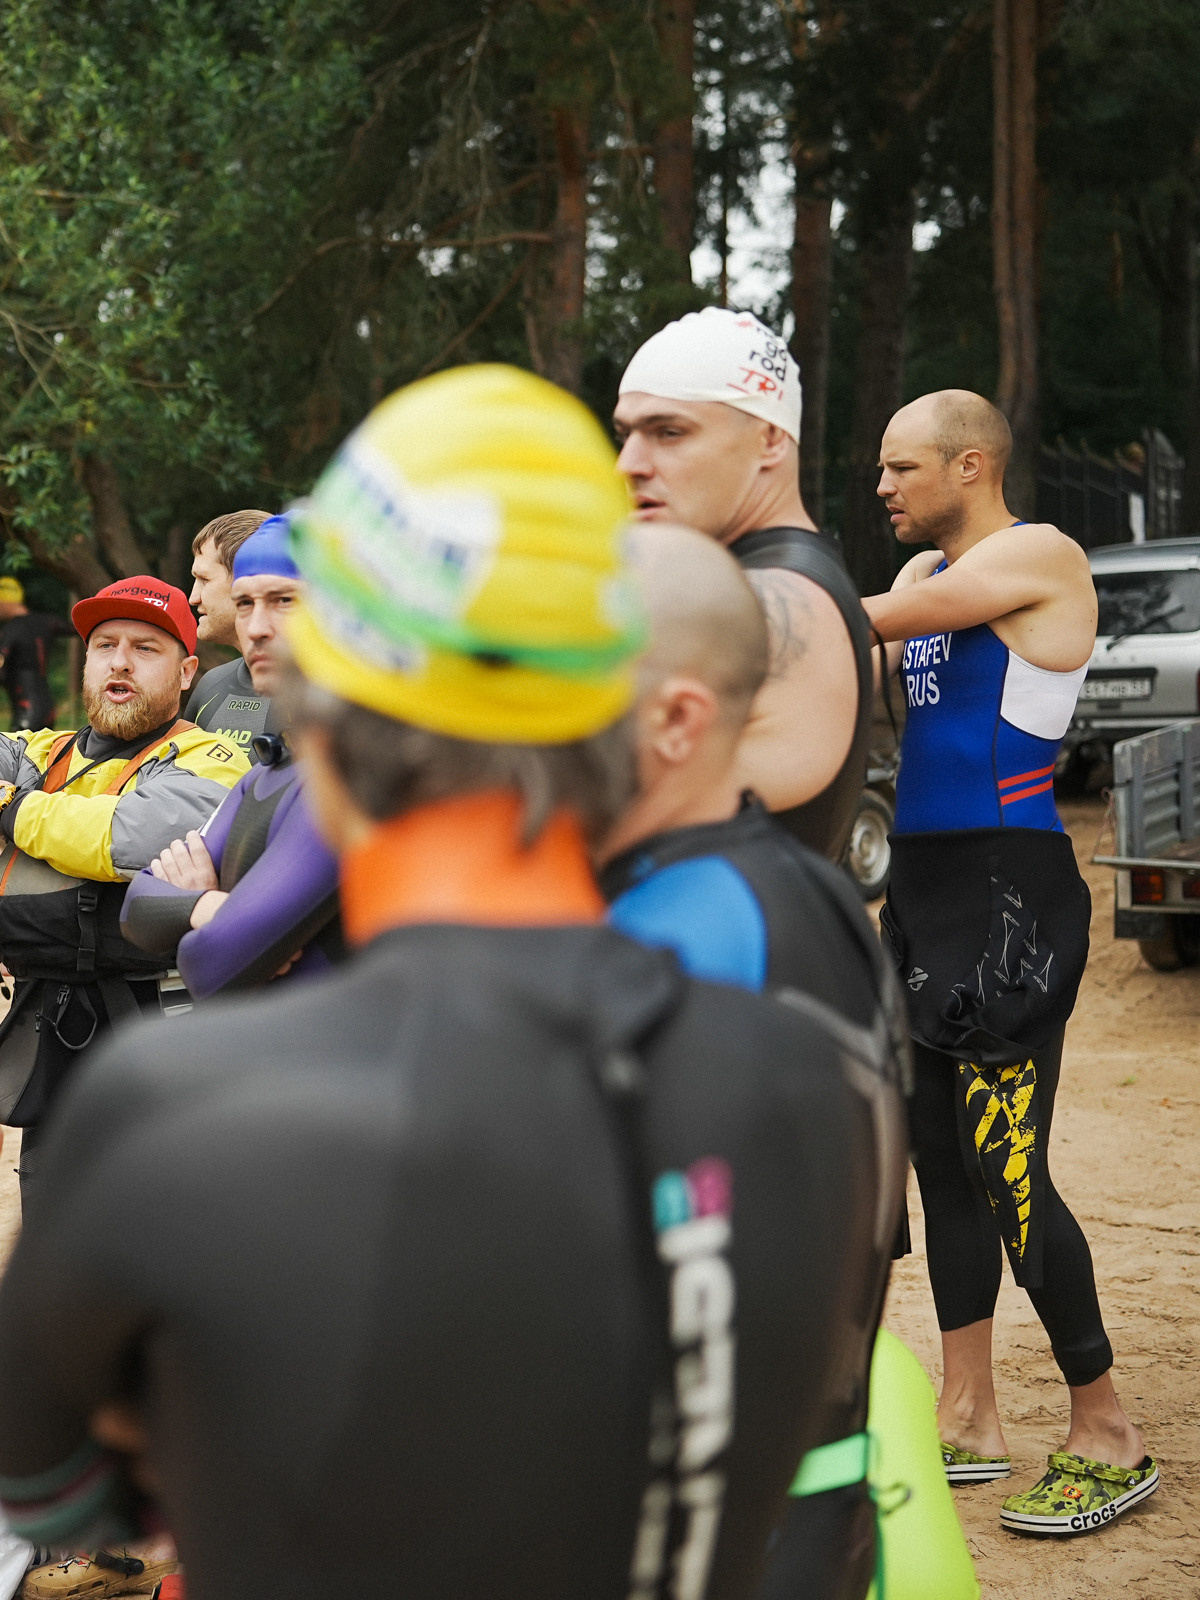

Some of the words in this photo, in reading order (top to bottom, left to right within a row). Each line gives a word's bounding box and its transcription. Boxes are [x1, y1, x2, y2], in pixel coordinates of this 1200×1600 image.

[110, 587, 171, 602] novgorod
[906, 671, 940, 708] RUS
[227, 700, 261, 711] RAPID
[1070, 1503, 1117, 1530] crocs
